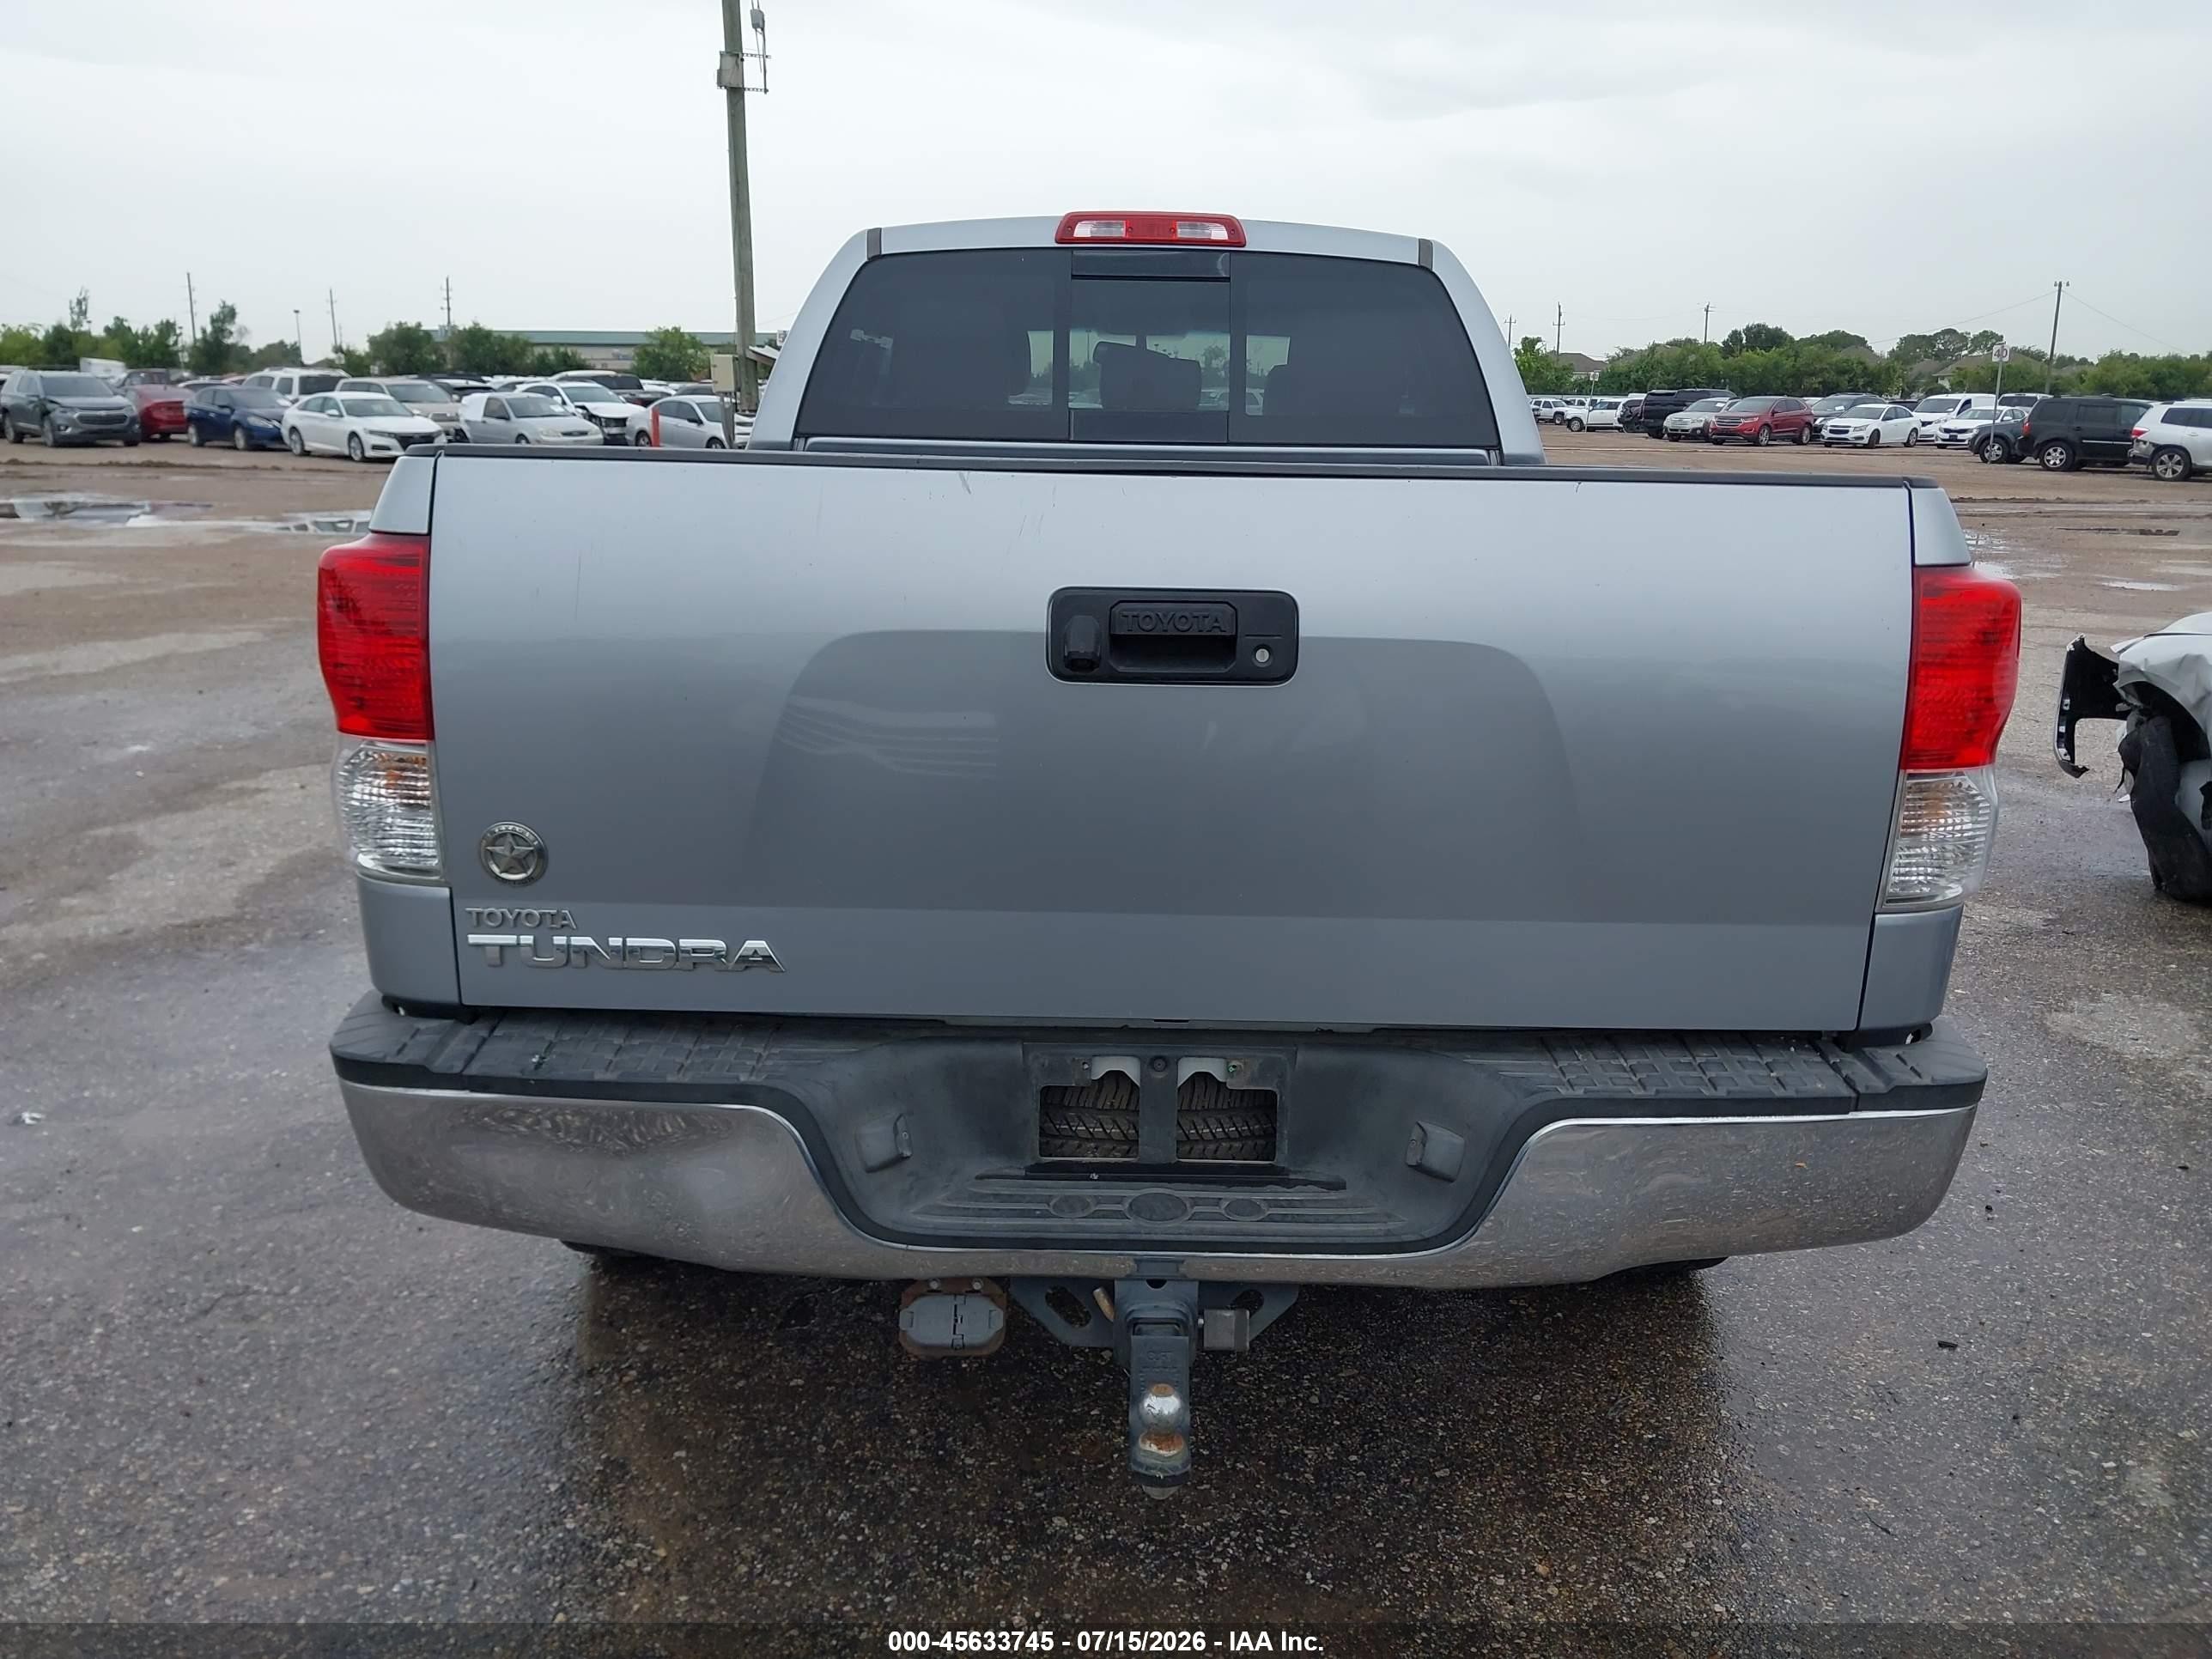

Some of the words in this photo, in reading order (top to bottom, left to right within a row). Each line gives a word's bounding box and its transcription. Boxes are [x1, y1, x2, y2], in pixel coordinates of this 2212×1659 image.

[1993, 348, 2008, 358] 40
[1121, 611, 1226, 633] TOYOTA
[465, 908, 577, 929] TOYOTA
[468, 933, 785, 972] TUNDRA
